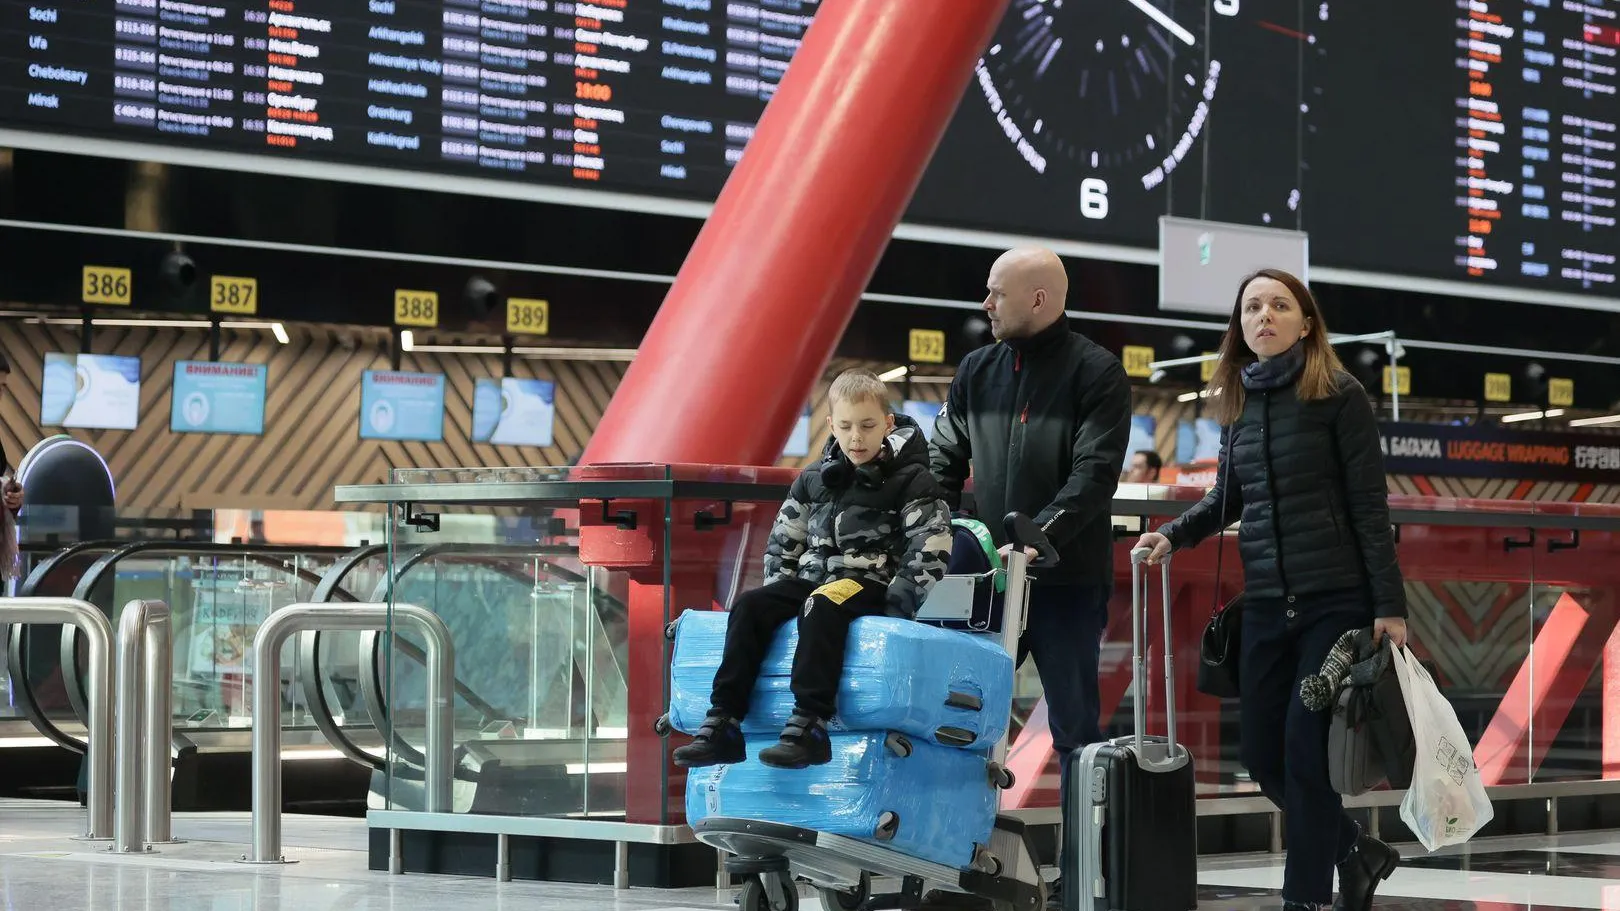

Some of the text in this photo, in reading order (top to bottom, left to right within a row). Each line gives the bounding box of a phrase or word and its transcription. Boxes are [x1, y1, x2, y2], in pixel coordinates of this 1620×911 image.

[29, 7, 57, 23] Sochi
[28, 35, 48, 50] Ufa
[28, 63, 88, 85] Cheboksary
[28, 92, 59, 108] Minsk
[1081, 178, 1108, 219] 6
[87, 273, 128, 297] 386
[214, 283, 253, 307] 387
[398, 297, 434, 319] 388
[511, 305, 545, 327] 389
[1446, 440, 1569, 465] LUGGAGE WRAPPING
